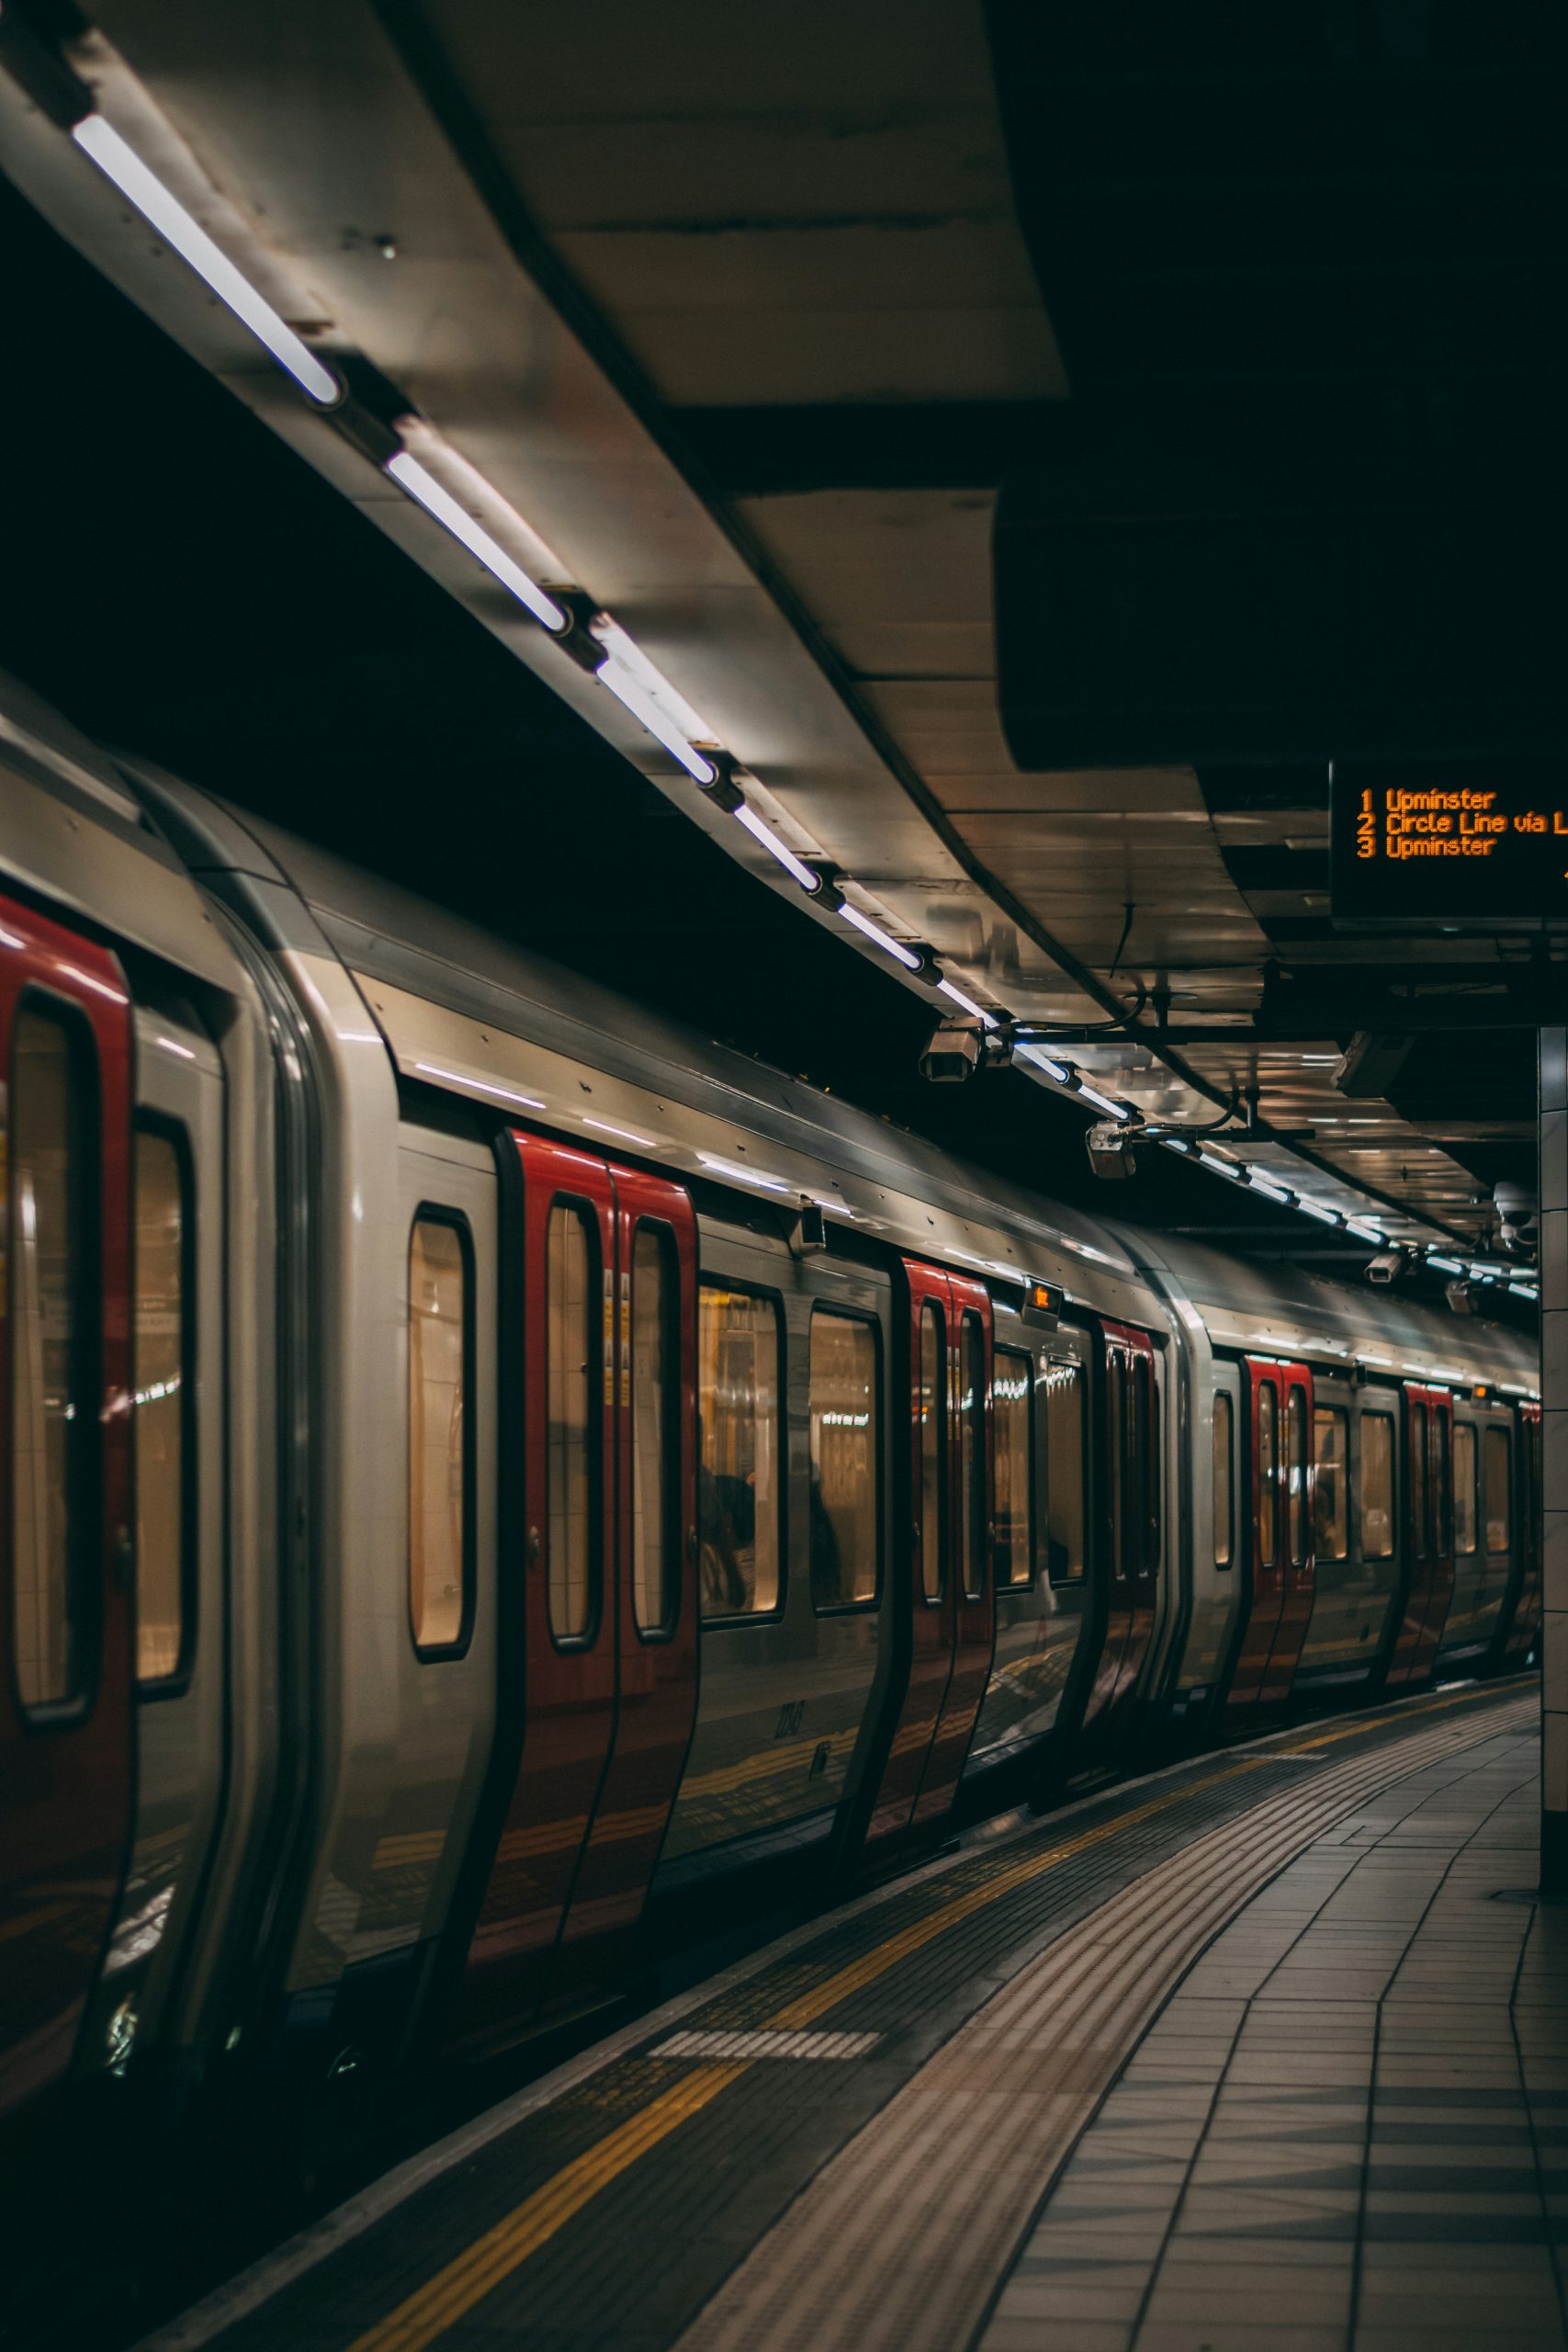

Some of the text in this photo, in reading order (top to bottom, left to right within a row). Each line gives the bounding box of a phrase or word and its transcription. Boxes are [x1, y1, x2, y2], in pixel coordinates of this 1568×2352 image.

[1361, 788, 1497, 813] 1 Upminster
[1357, 812, 1376, 835] 2
[1386, 812, 1453, 835] Circle
[1460, 811, 1508, 835] Line
[1514, 811, 1547, 833] via
[1357, 835, 1497, 860] 3 Upminster
